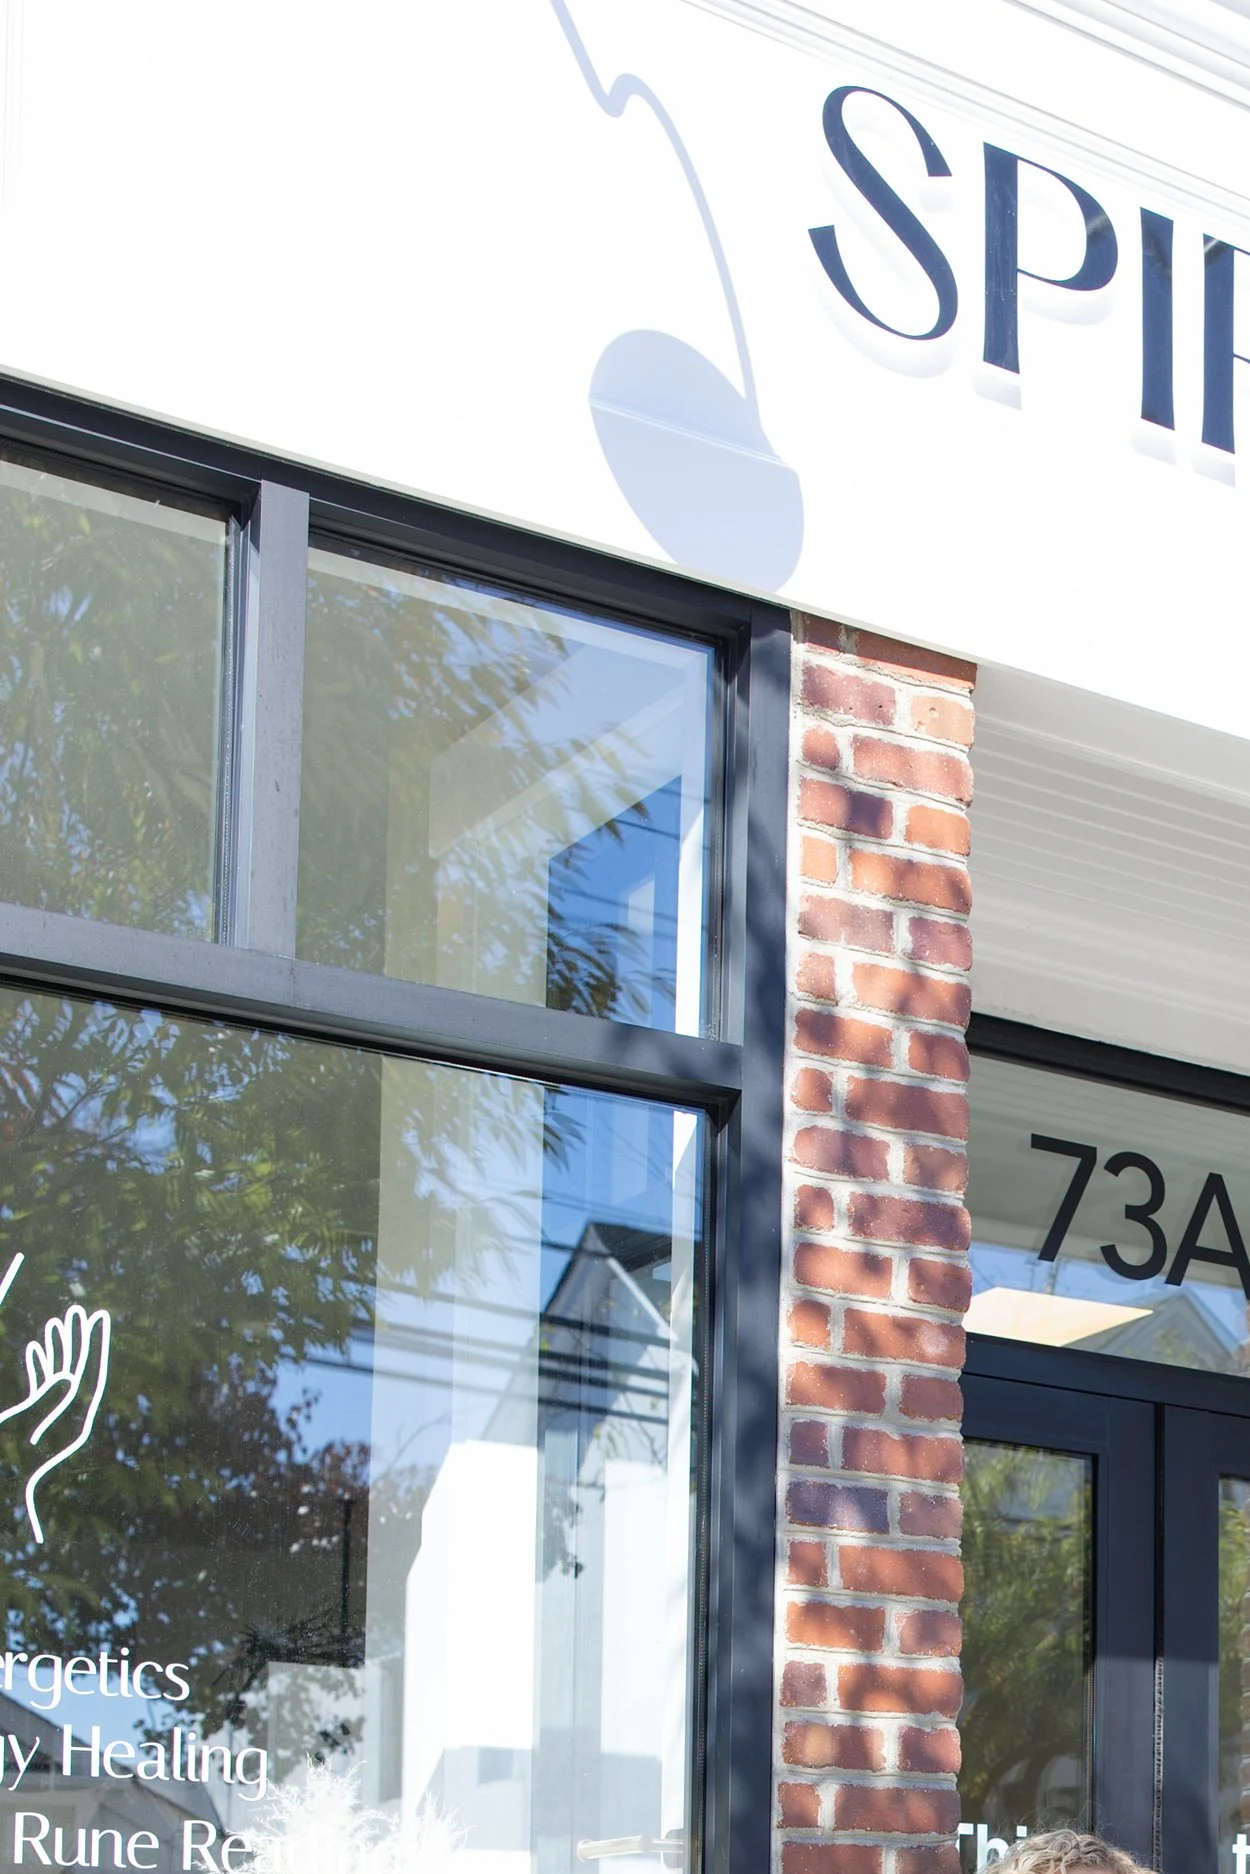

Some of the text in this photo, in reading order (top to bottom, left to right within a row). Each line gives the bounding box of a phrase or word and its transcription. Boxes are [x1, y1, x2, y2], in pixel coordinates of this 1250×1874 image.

[0, 1647, 190, 1710] rgetics
[0, 1724, 268, 1801] y Healing
[13, 1811, 159, 1869] Rune
